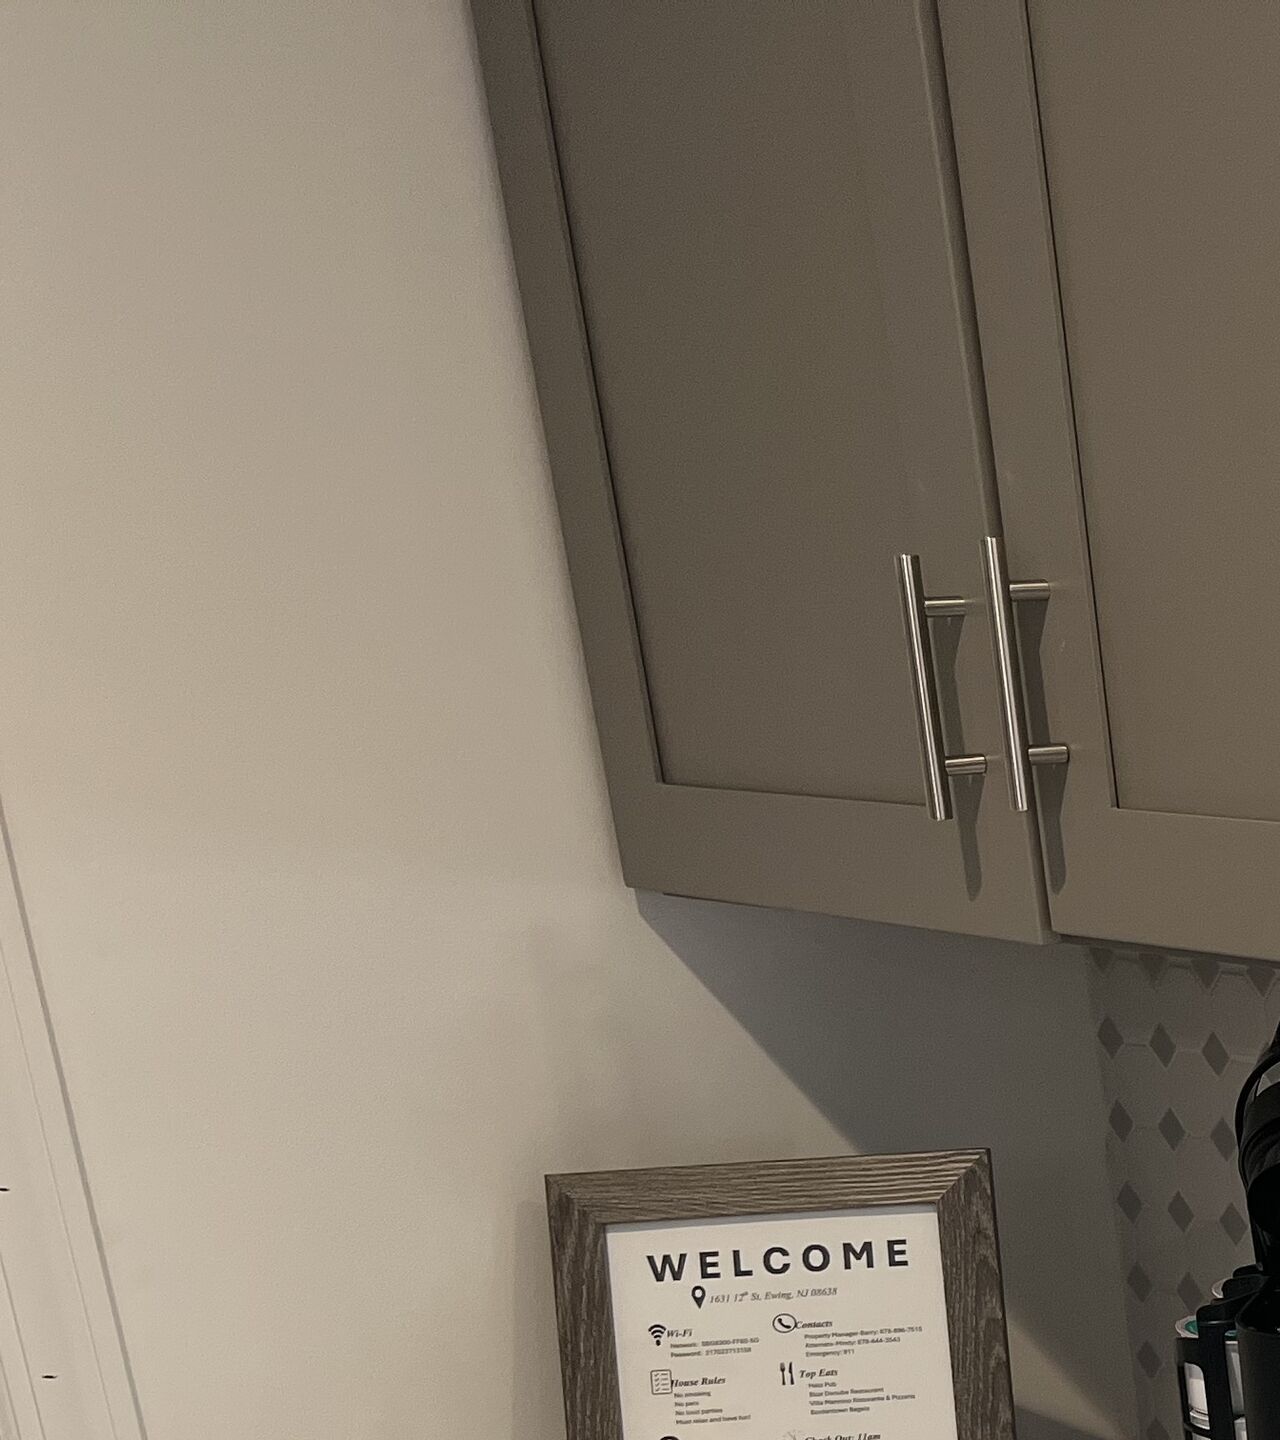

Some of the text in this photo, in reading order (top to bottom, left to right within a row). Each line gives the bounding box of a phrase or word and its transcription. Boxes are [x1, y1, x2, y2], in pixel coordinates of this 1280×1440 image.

[646, 1239, 909, 1282] WELCOME
[710, 1294, 730, 1304] 1631
[765, 1291, 794, 1300] Ewing,
[796, 1289, 809, 1298] NJ
[810, 1287, 838, 1297] 08638
[795, 1320, 833, 1329] Contacts
[666, 1328, 693, 1338] Wi-Fi
[799, 1368, 838, 1379] Top Eats
[671, 1376, 726, 1388] House Rules
